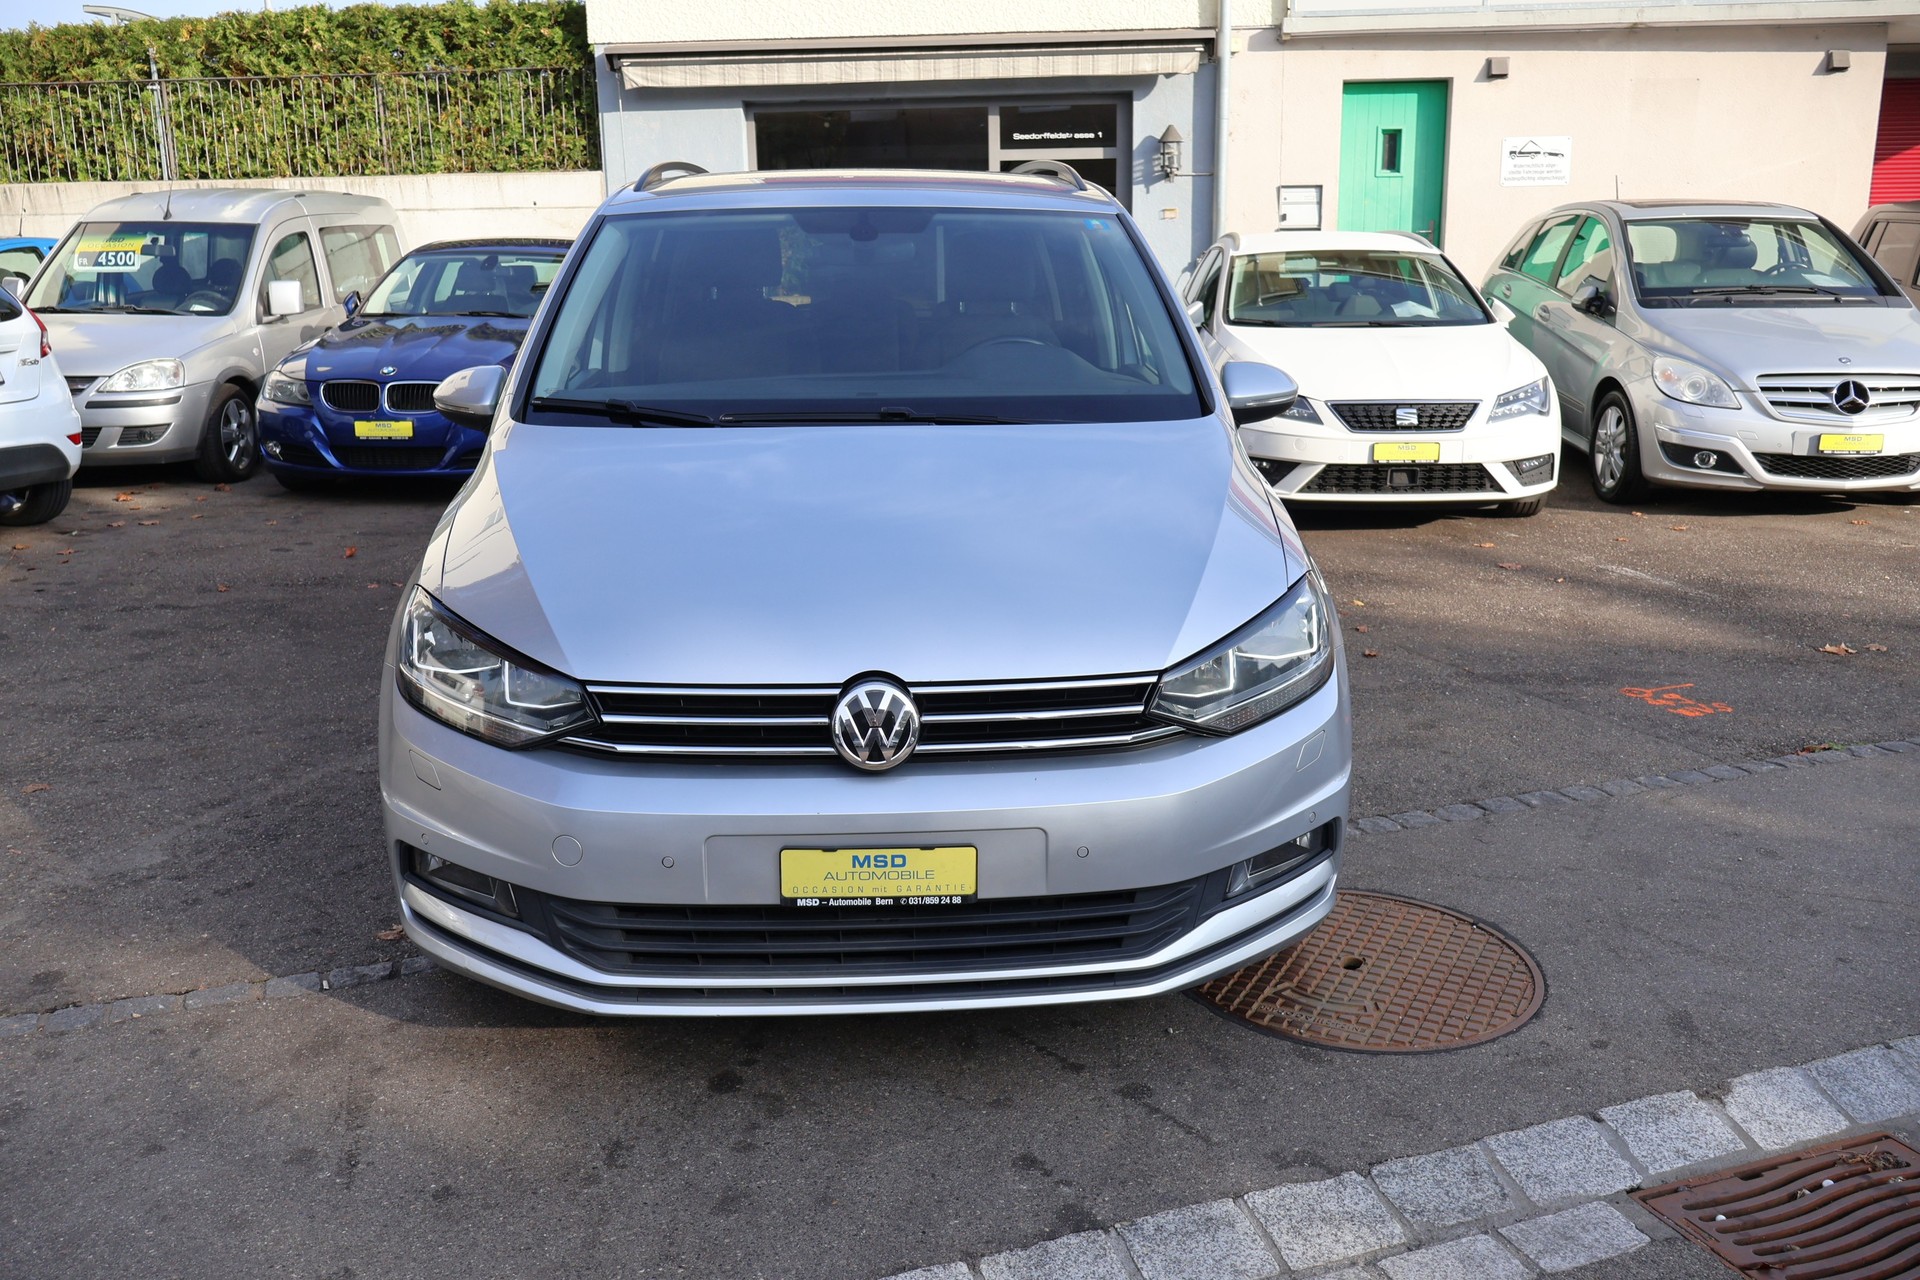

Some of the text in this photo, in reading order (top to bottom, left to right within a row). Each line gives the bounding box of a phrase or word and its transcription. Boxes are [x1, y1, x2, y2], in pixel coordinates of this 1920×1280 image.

[98, 251, 135, 266] 4500
[851, 854, 907, 868] MSD
[823, 870, 935, 881] AUTOMOBILE
[792, 885, 864, 894] OCCASION
[896, 883, 966, 893] GARANTIE
[797, 898, 820, 906] MSD
[829, 897, 872, 906] Automobile
[875, 897, 894, 905] Bern
[908, 896, 940, 905] 031/859
[940, 896, 951, 905] 24
[952, 896, 962, 904] 88
